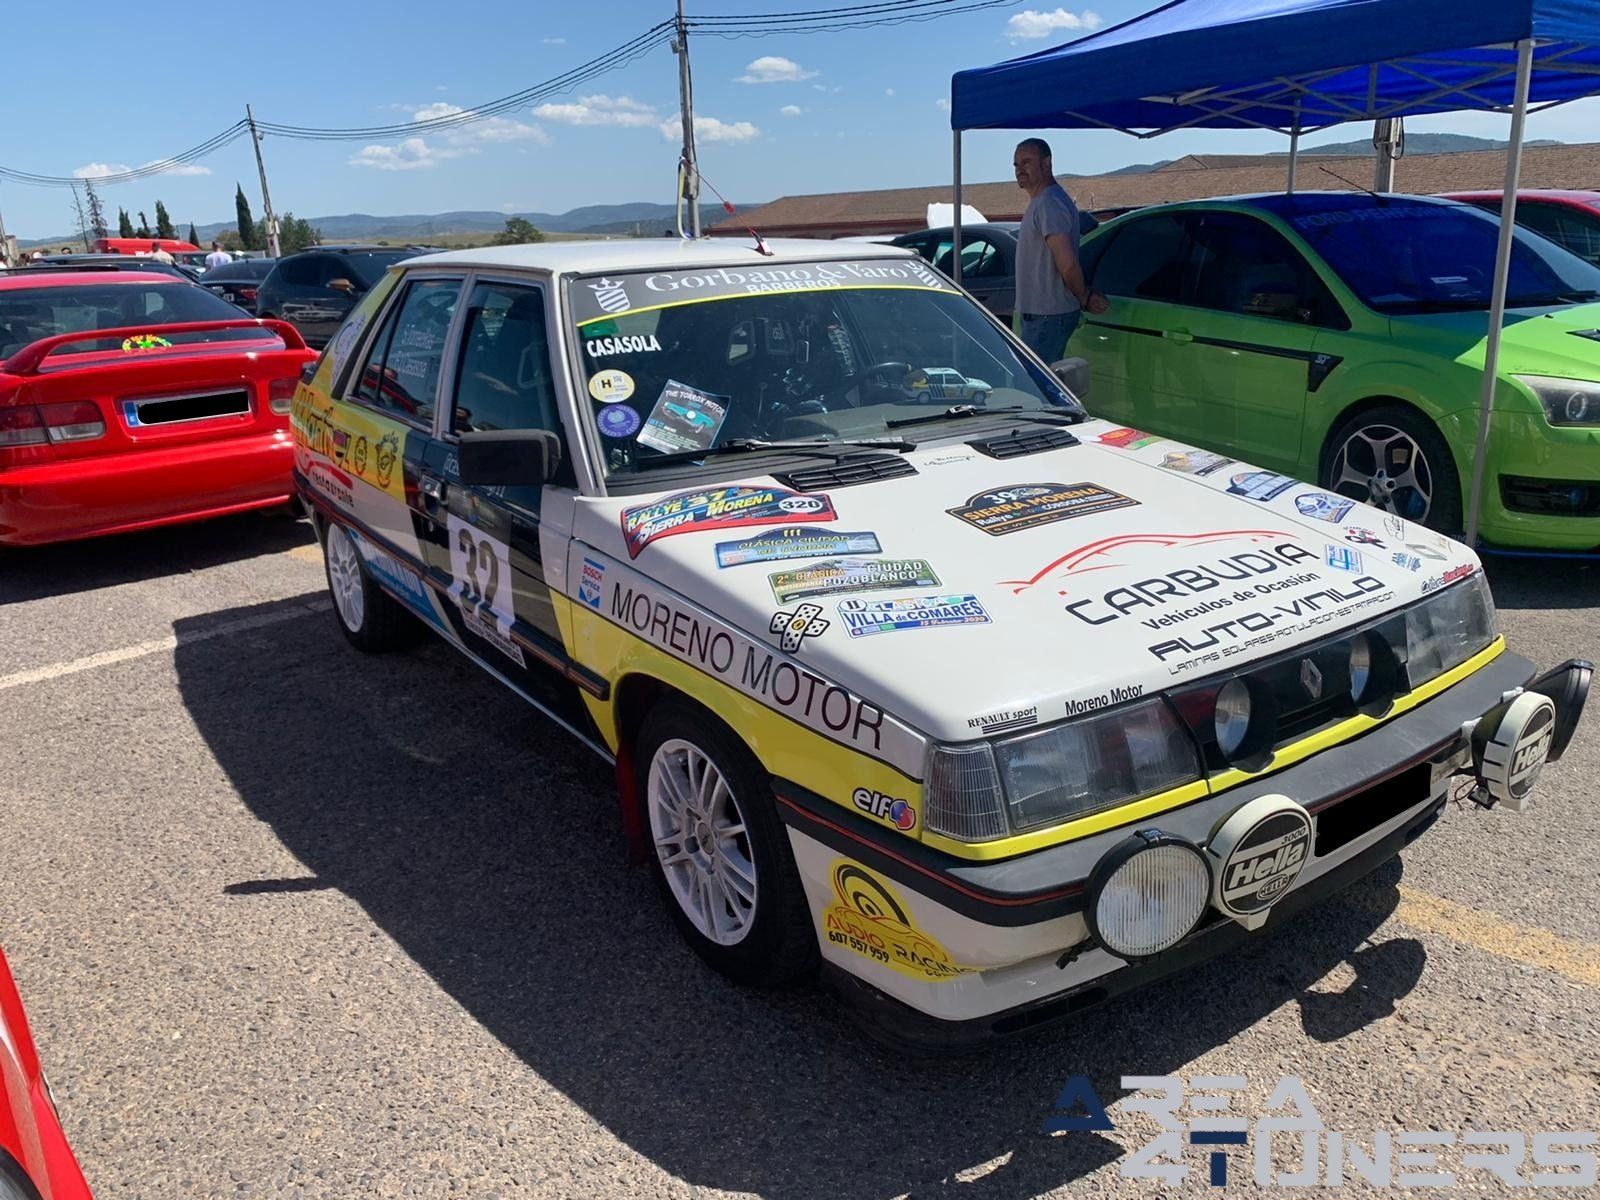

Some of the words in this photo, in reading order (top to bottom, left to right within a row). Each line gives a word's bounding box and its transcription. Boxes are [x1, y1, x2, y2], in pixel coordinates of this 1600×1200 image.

[1295, 210, 1353, 229] FORD
[645, 267, 810, 292] Gorbano
[816, 264, 846, 281] &
[845, 263, 908, 279] Varo
[746, 279, 841, 293] BARBEROS
[586, 334, 662, 358] CASASOLA
[601, 379, 612, 389] H
[782, 499, 819, 511] 320
[963, 501, 1027, 521] SIERRA
[1027, 488, 1104, 506] MORENA
[984, 491, 1017, 505] 39
[627, 499, 682, 531] RALLYE
[638, 512, 694, 544] SIERRA
[706, 493, 773, 517] MORENA
[976, 512, 1013, 526] Rallye
[783, 529, 800, 537] III
[799, 535, 850, 543] CIUDAD
[583, 564, 603, 582] BOSCH
[823, 570, 917, 587] POZOBLANCO
[867, 561, 922, 573] CIUDAD
[1064, 543, 1320, 625] CARBUDIA
[846, 600, 861, 609] II
[1141, 595, 1233, 630] Vehículos
[1230, 587, 1256, 602] de
[1253, 572, 1321, 594] Ocasión
[843, 611, 893, 628] VILLA
[896, 613, 907, 621] de
[907, 601, 984, 620] COMARES
[1147, 576, 1386, 662] AUTO-VINILO
[611, 582, 735, 673] MORENO
[741, 645, 884, 751] MOTOR
[1167, 651, 1220, 676] LAMINAS
[1065, 694, 1109, 716] Moreno
[1110, 684, 1143, 703] Motor
[967, 711, 1011, 728] RENAULT
[1012, 706, 1037, 721] sport
[1512, 734, 1551, 774] Hella
[853, 788, 890, 818] elf
[1281, 827, 1306, 845] 3000
[1229, 842, 1305, 889] Hella
[827, 913, 886, 949] AUDIO
[829, 931, 848, 945] 607
[850, 937, 868, 954] 557
[870, 946, 889, 963] 959
